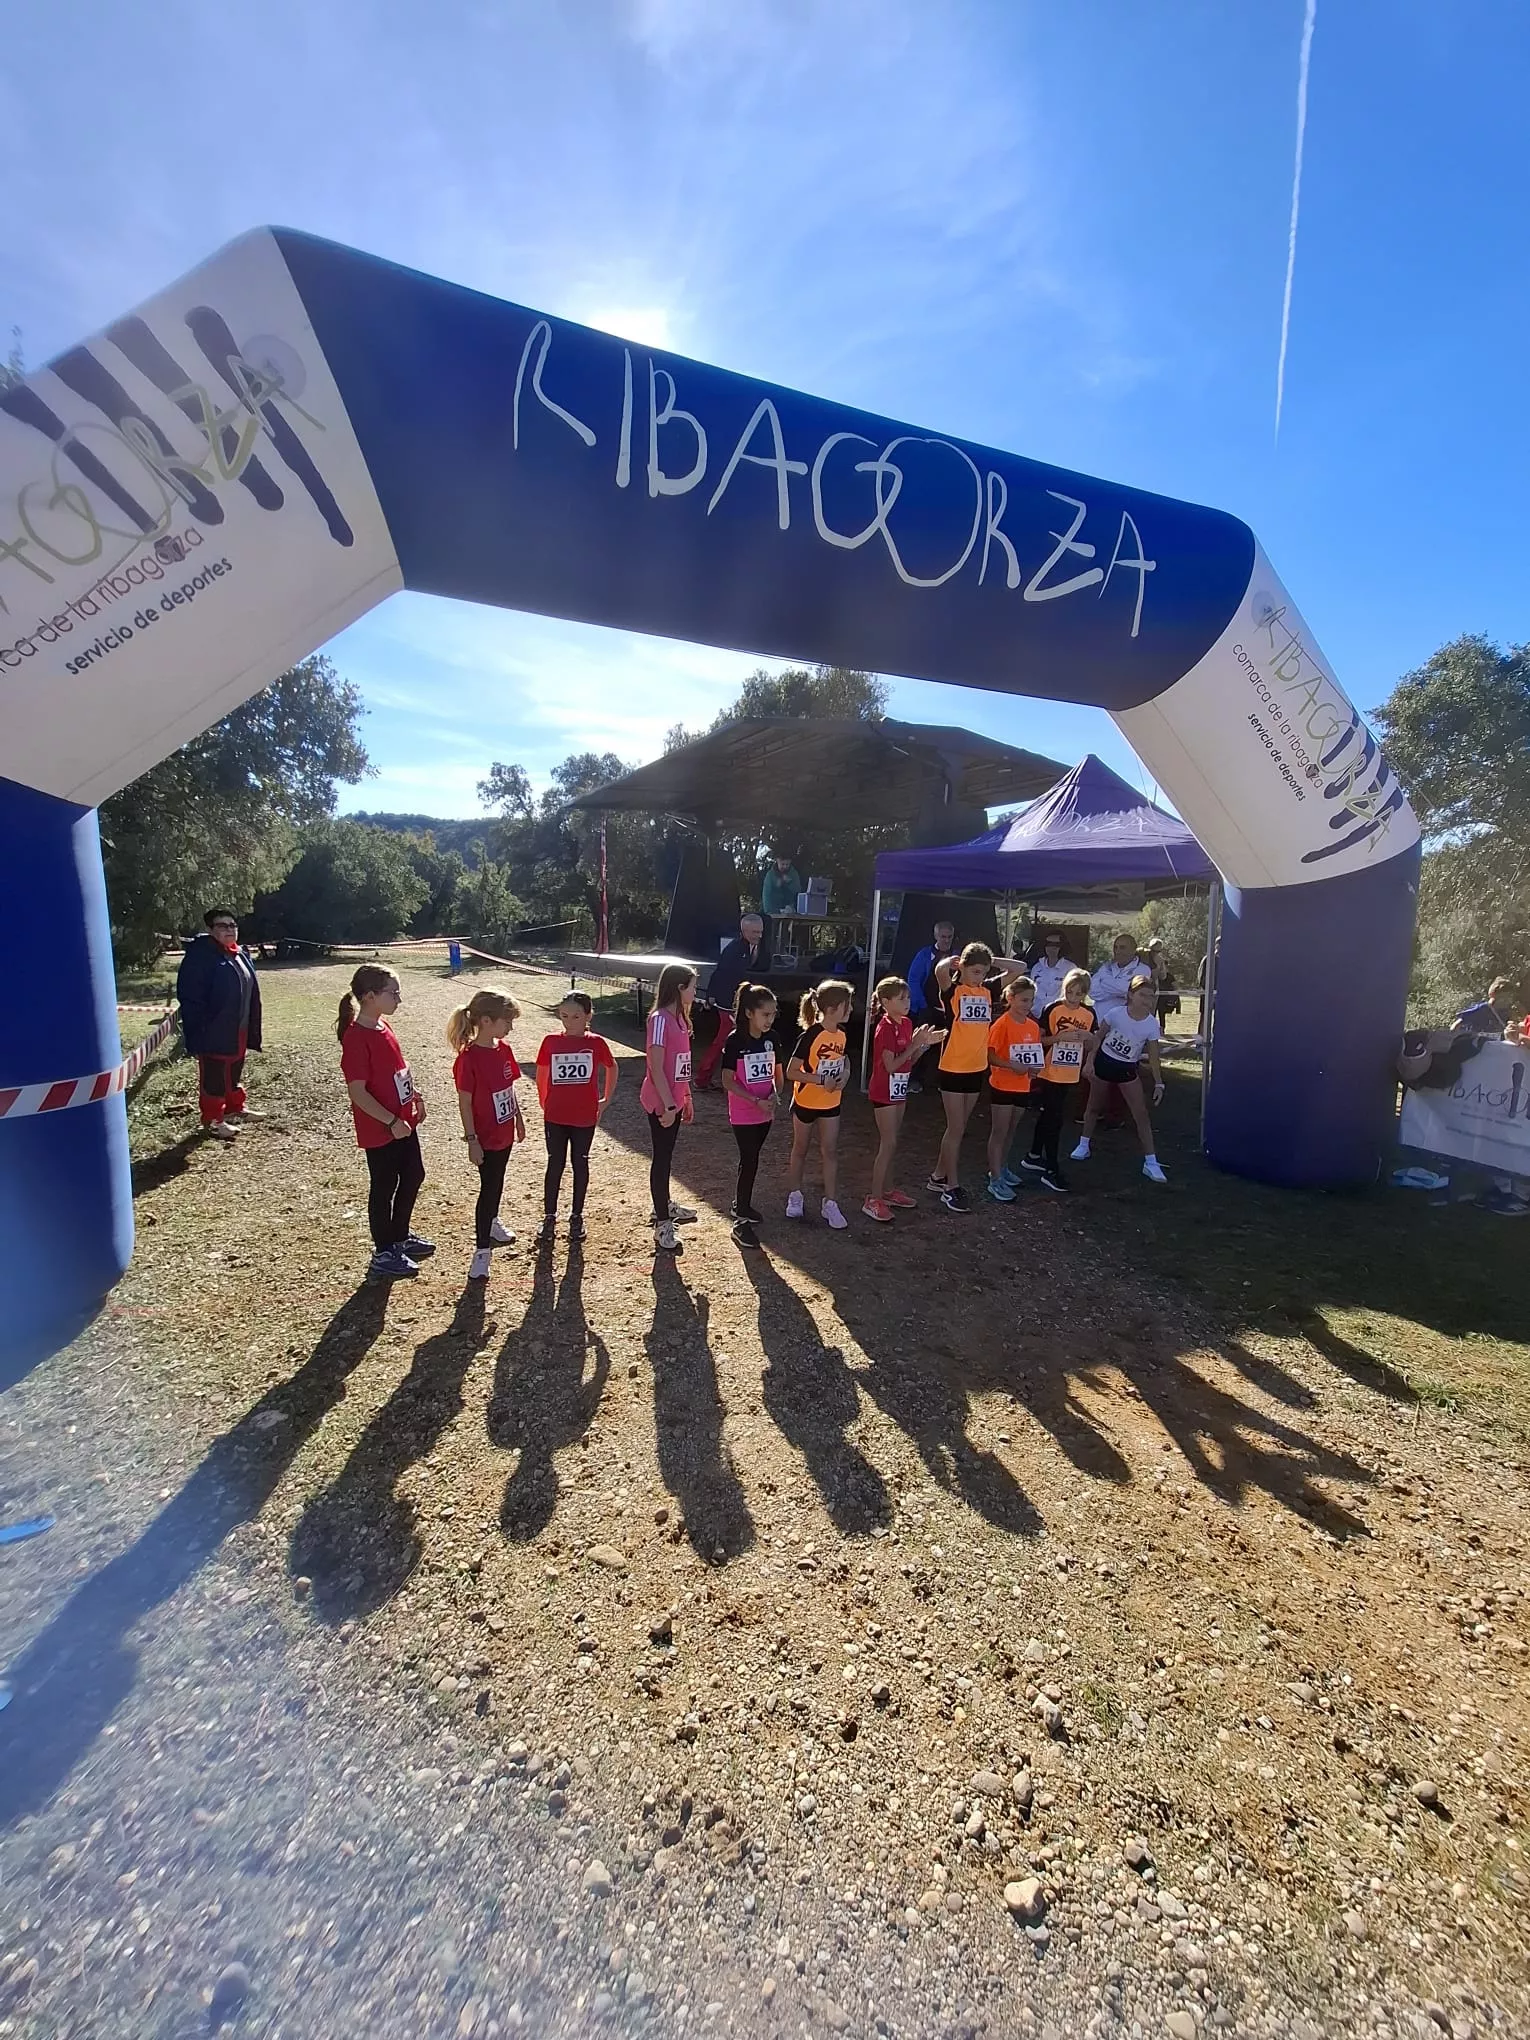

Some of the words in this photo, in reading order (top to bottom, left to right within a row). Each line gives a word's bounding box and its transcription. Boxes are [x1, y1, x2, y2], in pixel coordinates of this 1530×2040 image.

[514, 320, 1156, 637] RIBAGORZA
[37, 617, 74, 642] de
[65, 600, 102, 620] la
[65, 625, 134, 675] servicio
[133, 608, 160, 629] de
[160, 557, 233, 612] deportes
[1232, 644, 1272, 703] comarca
[1267, 702, 1283, 721] de
[1278, 719, 1292, 735] la
[1248, 713, 1273, 748] servicio
[1270, 749, 1282, 763] de
[1278, 763, 1306, 802] deportes
[965, 1005, 987, 1018] 362
[1110, 1037, 1132, 1055] 359
[1015, 1052, 1038, 1064] 361
[1057, 1050, 1079, 1062] 363
[557, 1064, 588, 1079] 320
[750, 1062, 773, 1077] 343
